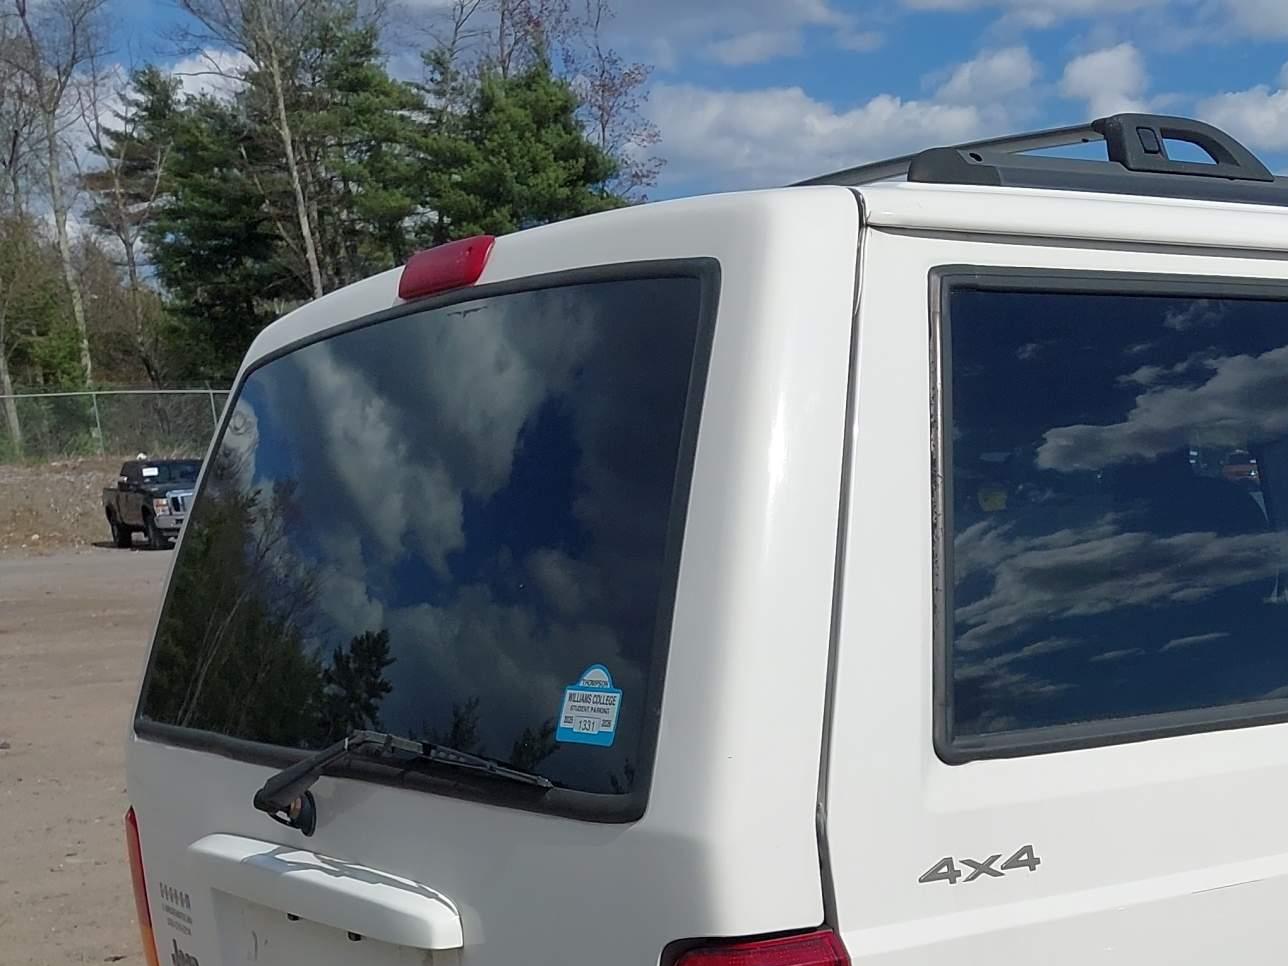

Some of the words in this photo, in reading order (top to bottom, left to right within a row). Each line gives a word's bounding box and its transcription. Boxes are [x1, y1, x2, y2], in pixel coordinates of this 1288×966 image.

[568, 693, 592, 705] WILLIAMS
[592, 695, 617, 706] COLLEGE
[578, 719, 596, 732] 1331
